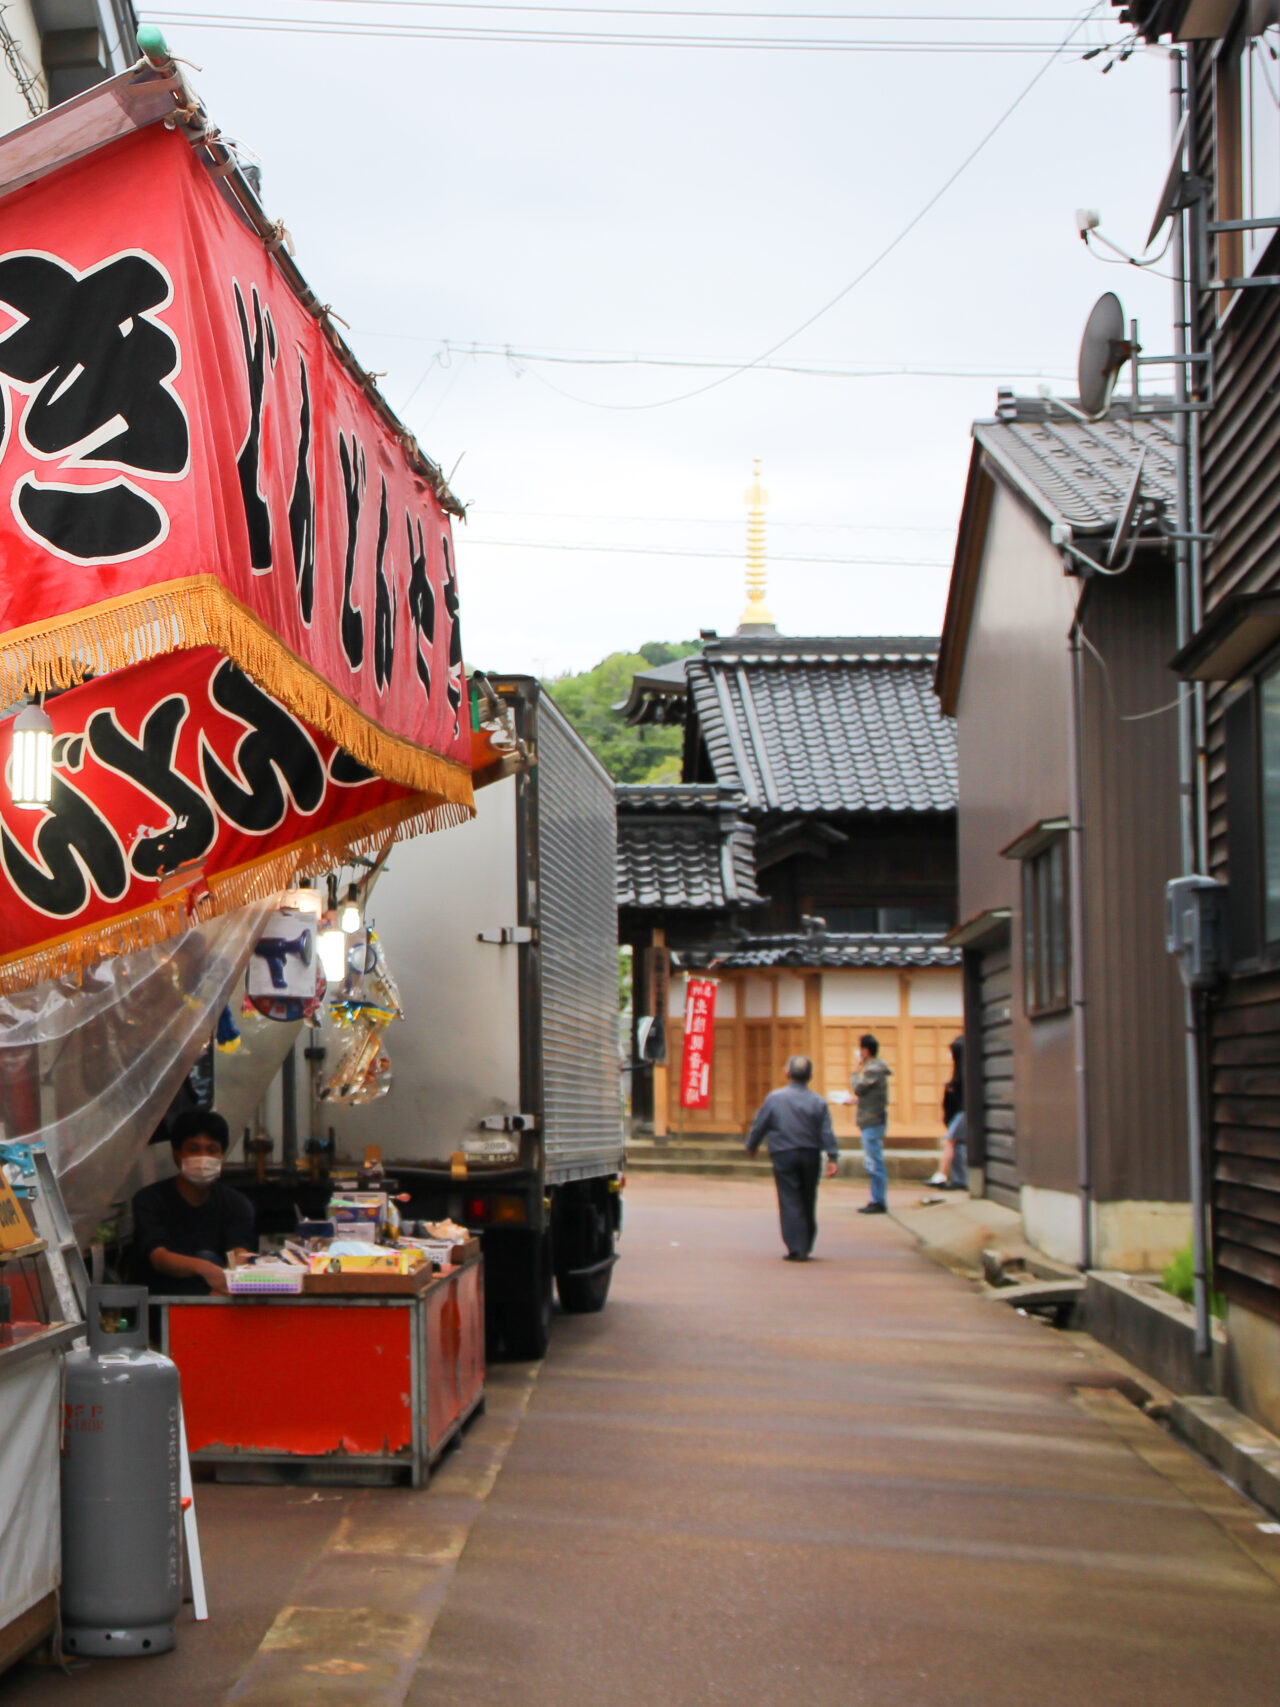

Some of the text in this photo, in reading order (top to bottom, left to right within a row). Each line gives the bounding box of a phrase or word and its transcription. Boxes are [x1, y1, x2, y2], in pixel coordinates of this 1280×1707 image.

[232, 276, 463, 742] どんどんやき
